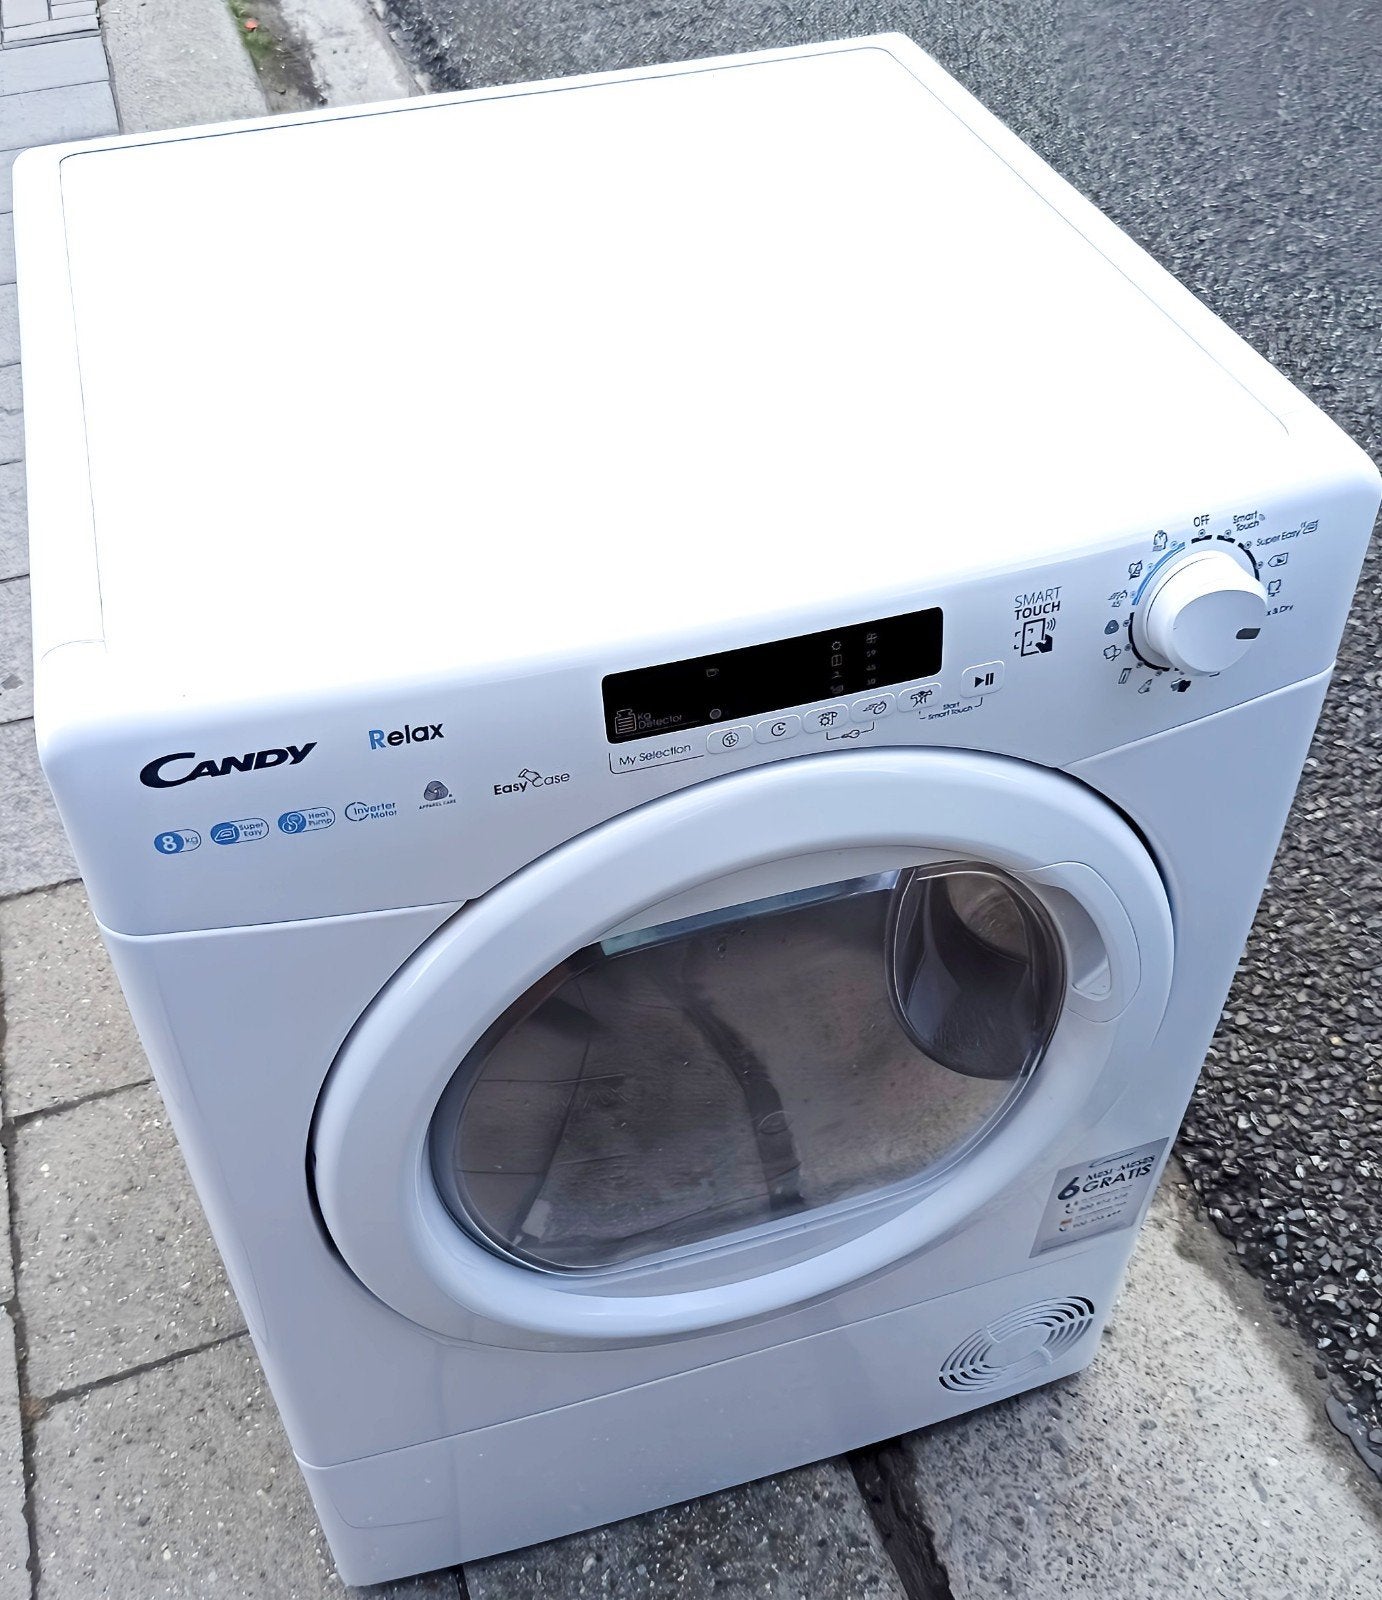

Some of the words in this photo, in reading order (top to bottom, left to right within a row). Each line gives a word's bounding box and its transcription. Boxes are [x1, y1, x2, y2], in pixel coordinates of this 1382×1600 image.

[1193, 514, 1210, 528] OFF
[1232, 511, 1258, 524] Smart
[1236, 520, 1260, 532] Touch
[1256, 534, 1281, 547] Super
[1281, 529, 1301, 541] Easy
[1015, 586, 1062, 609] SMART
[1015, 600, 1061, 620] TOUCH
[928, 709, 950, 720] Smart
[951, 705, 973, 716] Touch
[638, 713, 683, 731] Detector
[368, 723, 445, 751] Relax
[619, 754, 637, 768] My
[639, 743, 692, 762] Selection
[139, 741, 318, 789] CANDY
[307, 809, 330, 820] Heat
[353, 801, 397, 816] Inverter
[370, 809, 398, 820] Motor
[238, 821, 264, 834] Super
[307, 816, 333, 828] Pump
[243, 828, 263, 840] Easy
[161, 835, 177, 852] 8
[184, 835, 199, 848] kg
[1057, 1176, 1081, 1200] 6
[1082, 1163, 1152, 1192] GRATIS
